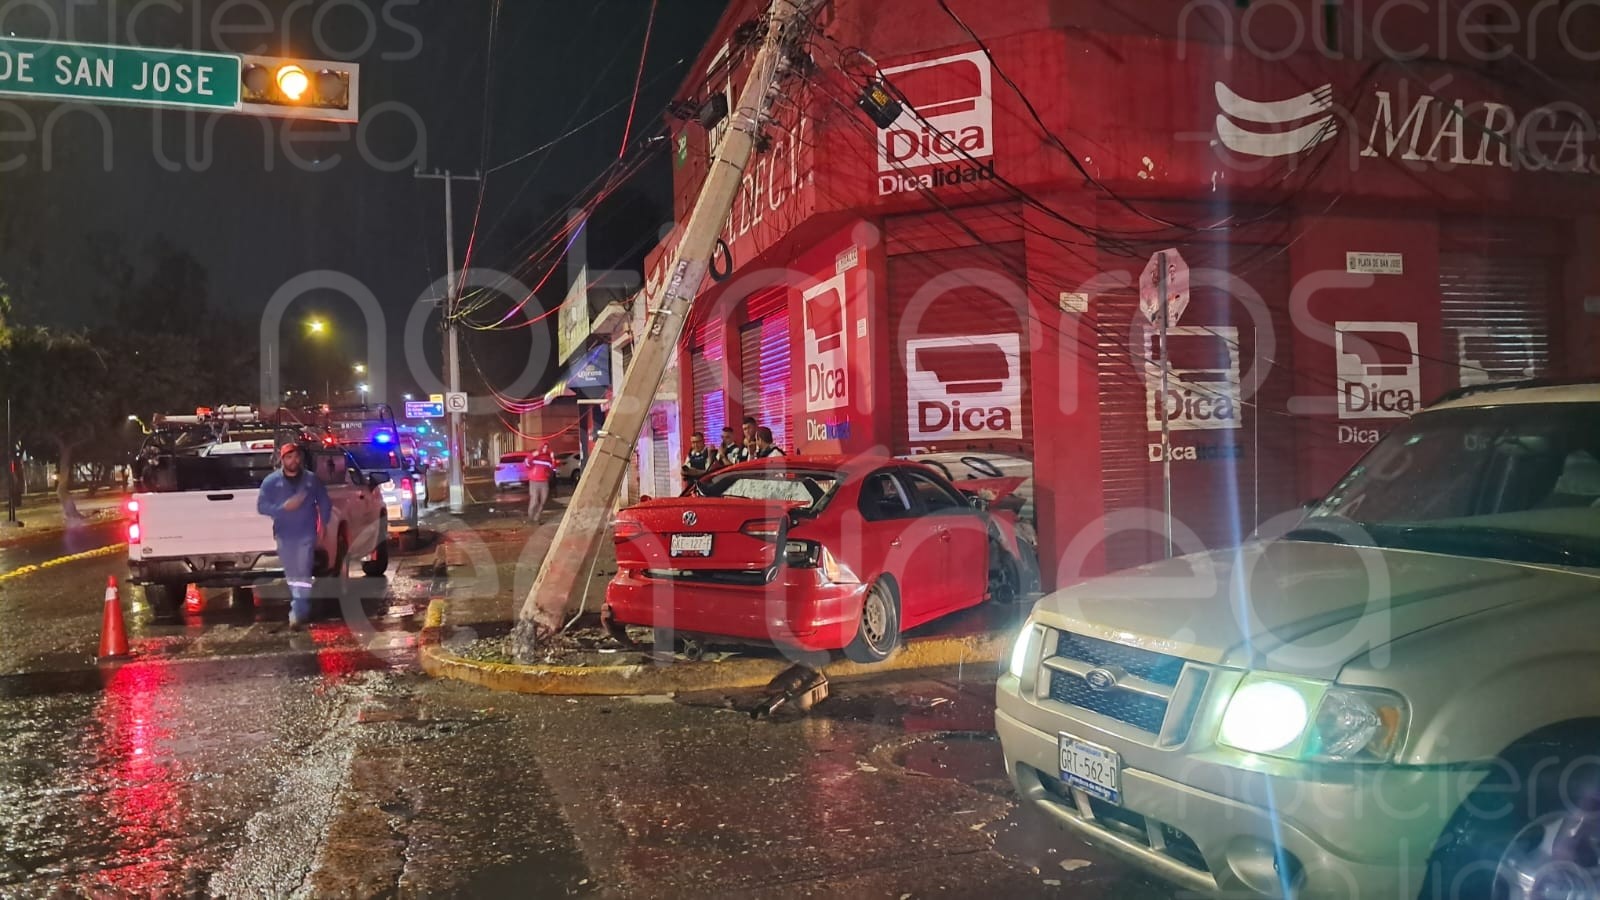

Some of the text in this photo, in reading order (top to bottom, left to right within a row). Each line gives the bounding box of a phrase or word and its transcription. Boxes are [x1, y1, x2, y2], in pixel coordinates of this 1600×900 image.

[55, 55, 114, 89] SAN
[132, 62, 214, 96] JOSE
[885, 125, 985, 164] Dica
[878, 160, 994, 196] Dicalidad
[807, 362, 846, 403] Dica
[1344, 382, 1414, 412] Dica
[918, 399, 1012, 433] Dica
[1154, 389, 1234, 422] Dica
